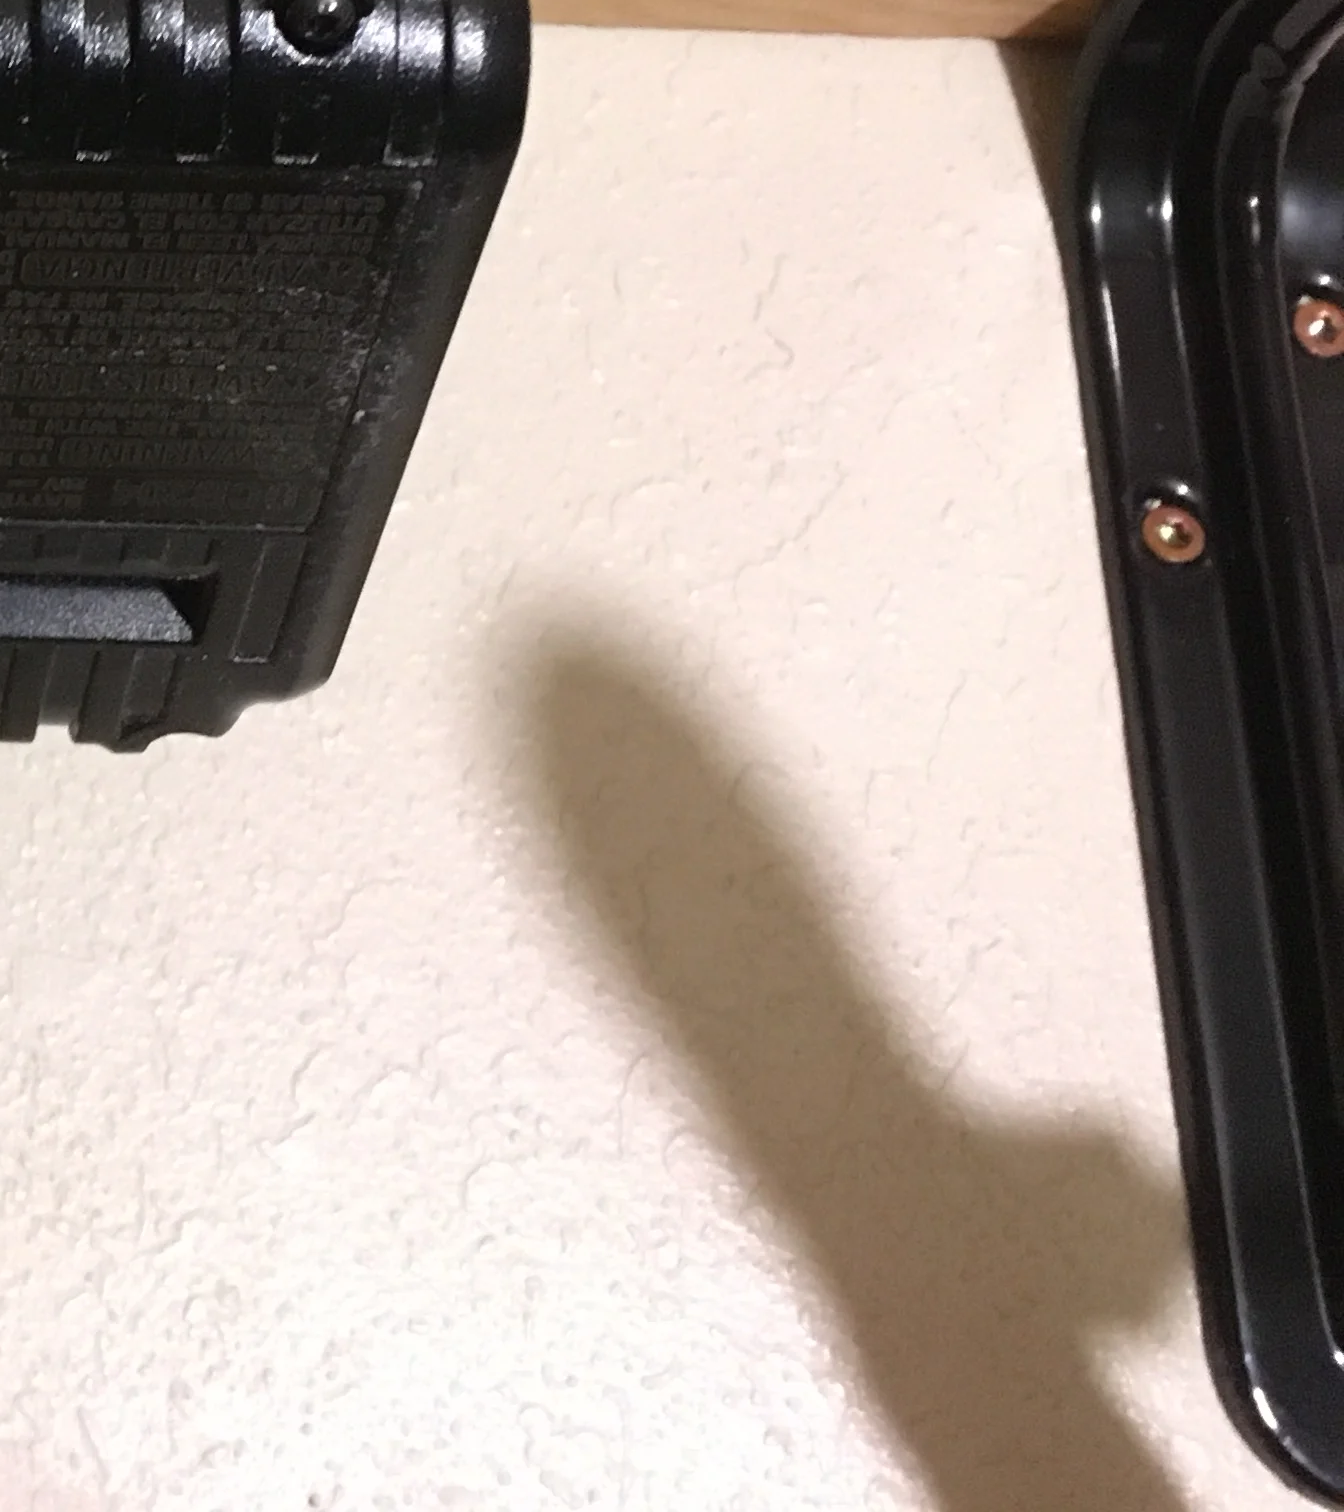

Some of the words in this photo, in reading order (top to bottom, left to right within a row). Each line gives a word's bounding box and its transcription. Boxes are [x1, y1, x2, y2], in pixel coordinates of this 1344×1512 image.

[34, 252, 305, 286] ADVERTENCIA
[17, 453, 51, 468] TO
[65, 439, 260, 469] WARNING
